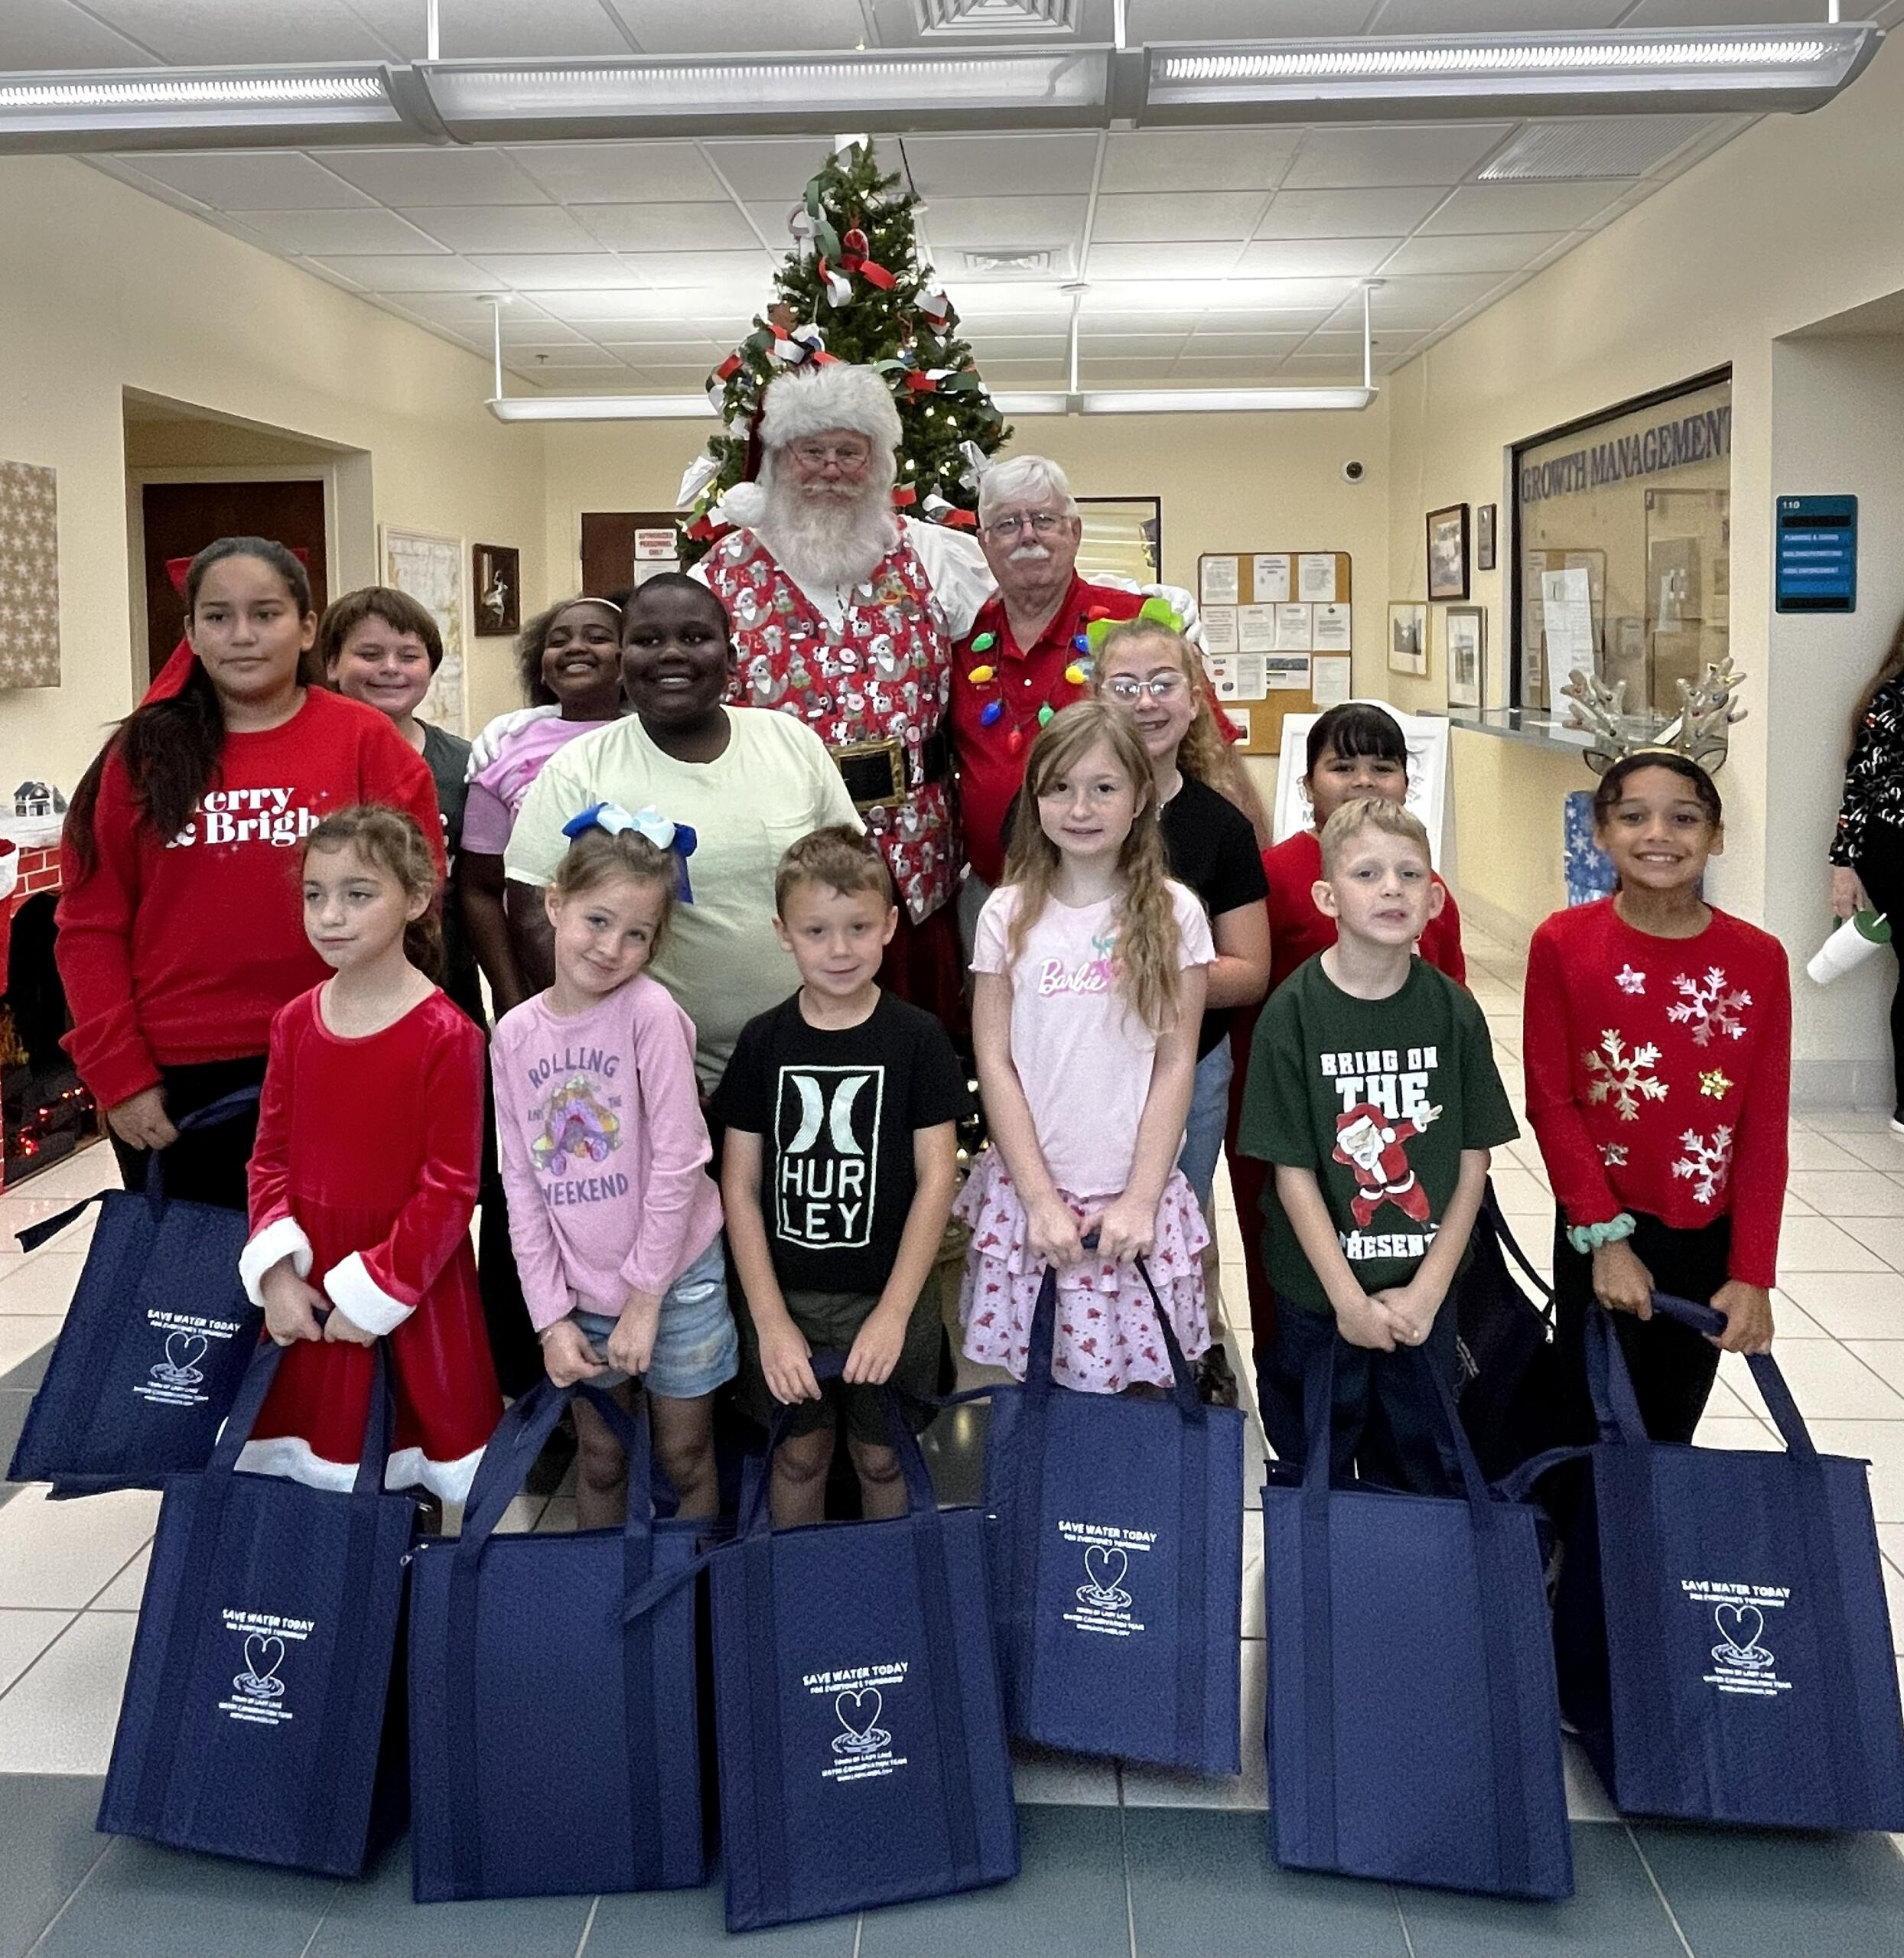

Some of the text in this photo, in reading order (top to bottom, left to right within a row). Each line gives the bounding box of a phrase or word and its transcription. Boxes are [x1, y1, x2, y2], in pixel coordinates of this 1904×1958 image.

[1521, 405, 1731, 503] GROWTH MANAGEMENT
[195, 787, 295, 815] erry
[203, 807, 321, 847] Brigh
[1037, 958, 1108, 996] Barbie
[528, 1046, 620, 1089] ROLLING
[1320, 1046, 1439, 1076] BRING ON
[1335, 1072, 1430, 1120] THE
[782, 1156, 865, 1199] HUR
[782, 1197, 863, 1240] LEY
[147, 1309, 242, 1332] SAVE WATER TODAY
[1058, 1520, 1157, 1543] SAVE WATER TODAY
[1681, 1579, 1791, 1599] SAVE WATER TODAY
[222, 1608, 315, 1632] SAVE WATER TODAY
[802, 1661, 909, 1686] SAVE WATER TODAY
